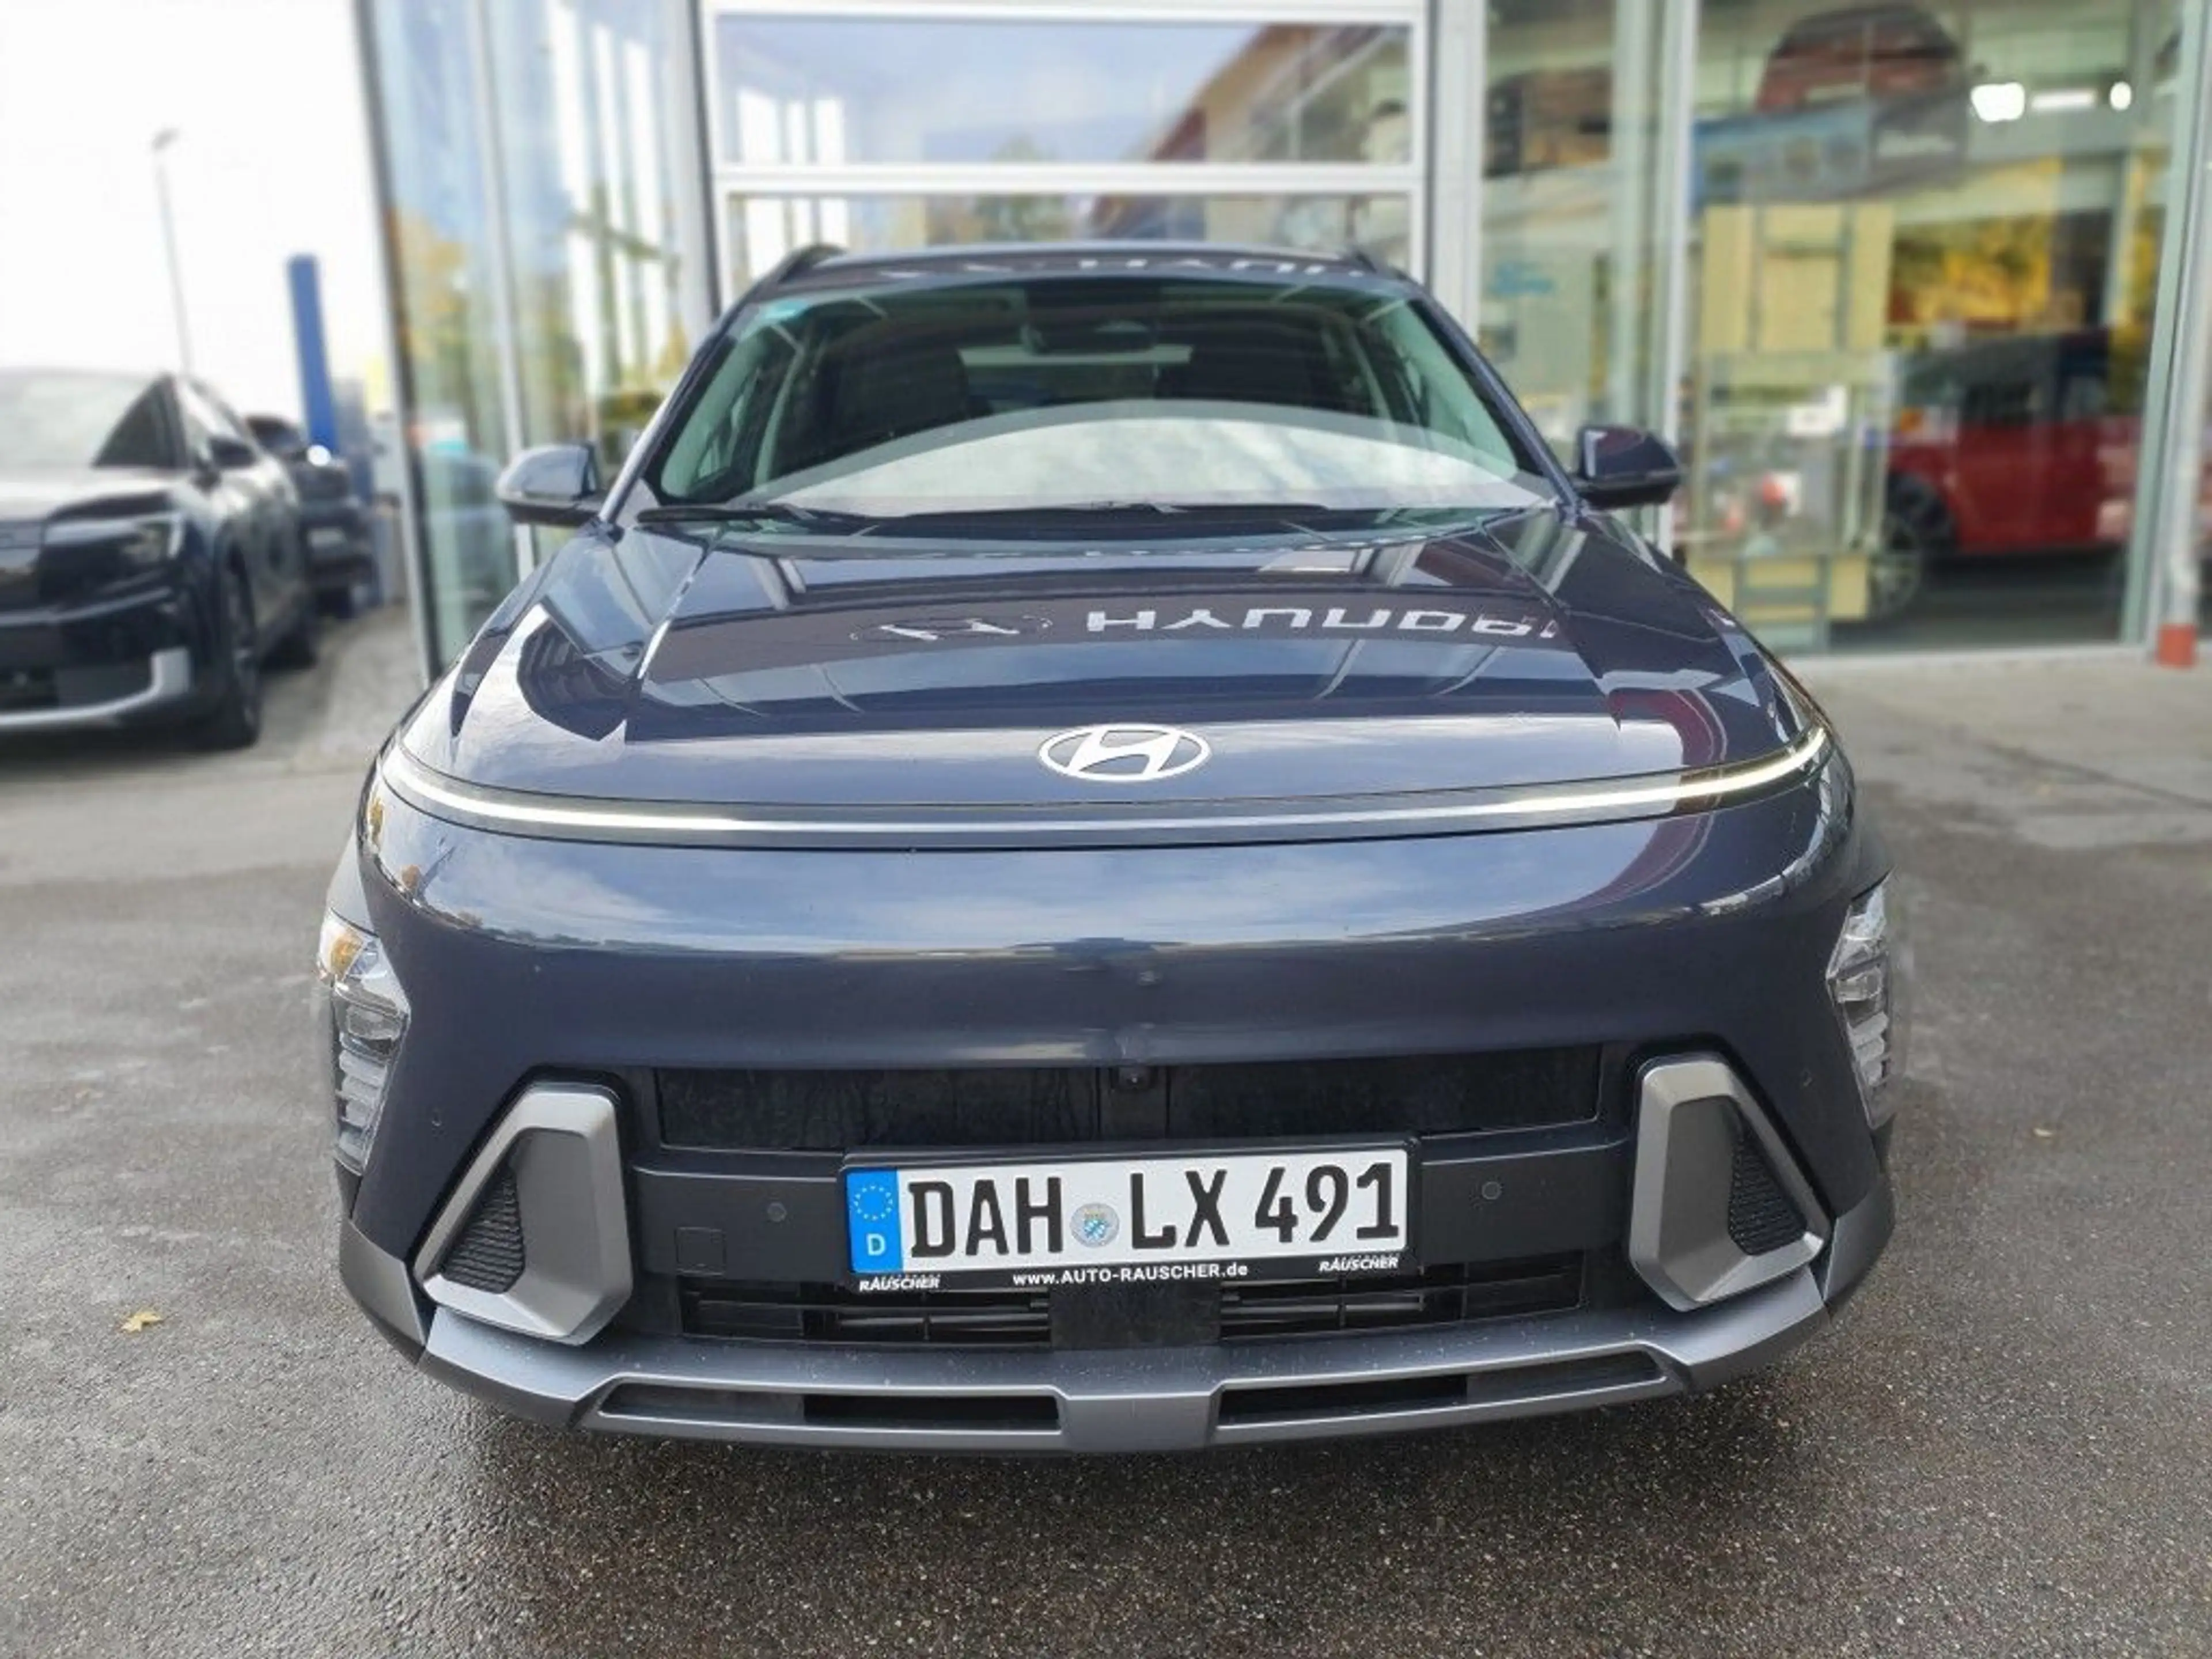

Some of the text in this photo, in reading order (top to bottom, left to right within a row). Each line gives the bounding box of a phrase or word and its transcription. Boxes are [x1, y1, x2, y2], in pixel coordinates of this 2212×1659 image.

[908, 1162, 1400, 1258] DAH LX 491
[867, 1233, 886, 1256] D
[1013, 1262, 1249, 1286] www.AUTO-RAUSCHER.de
